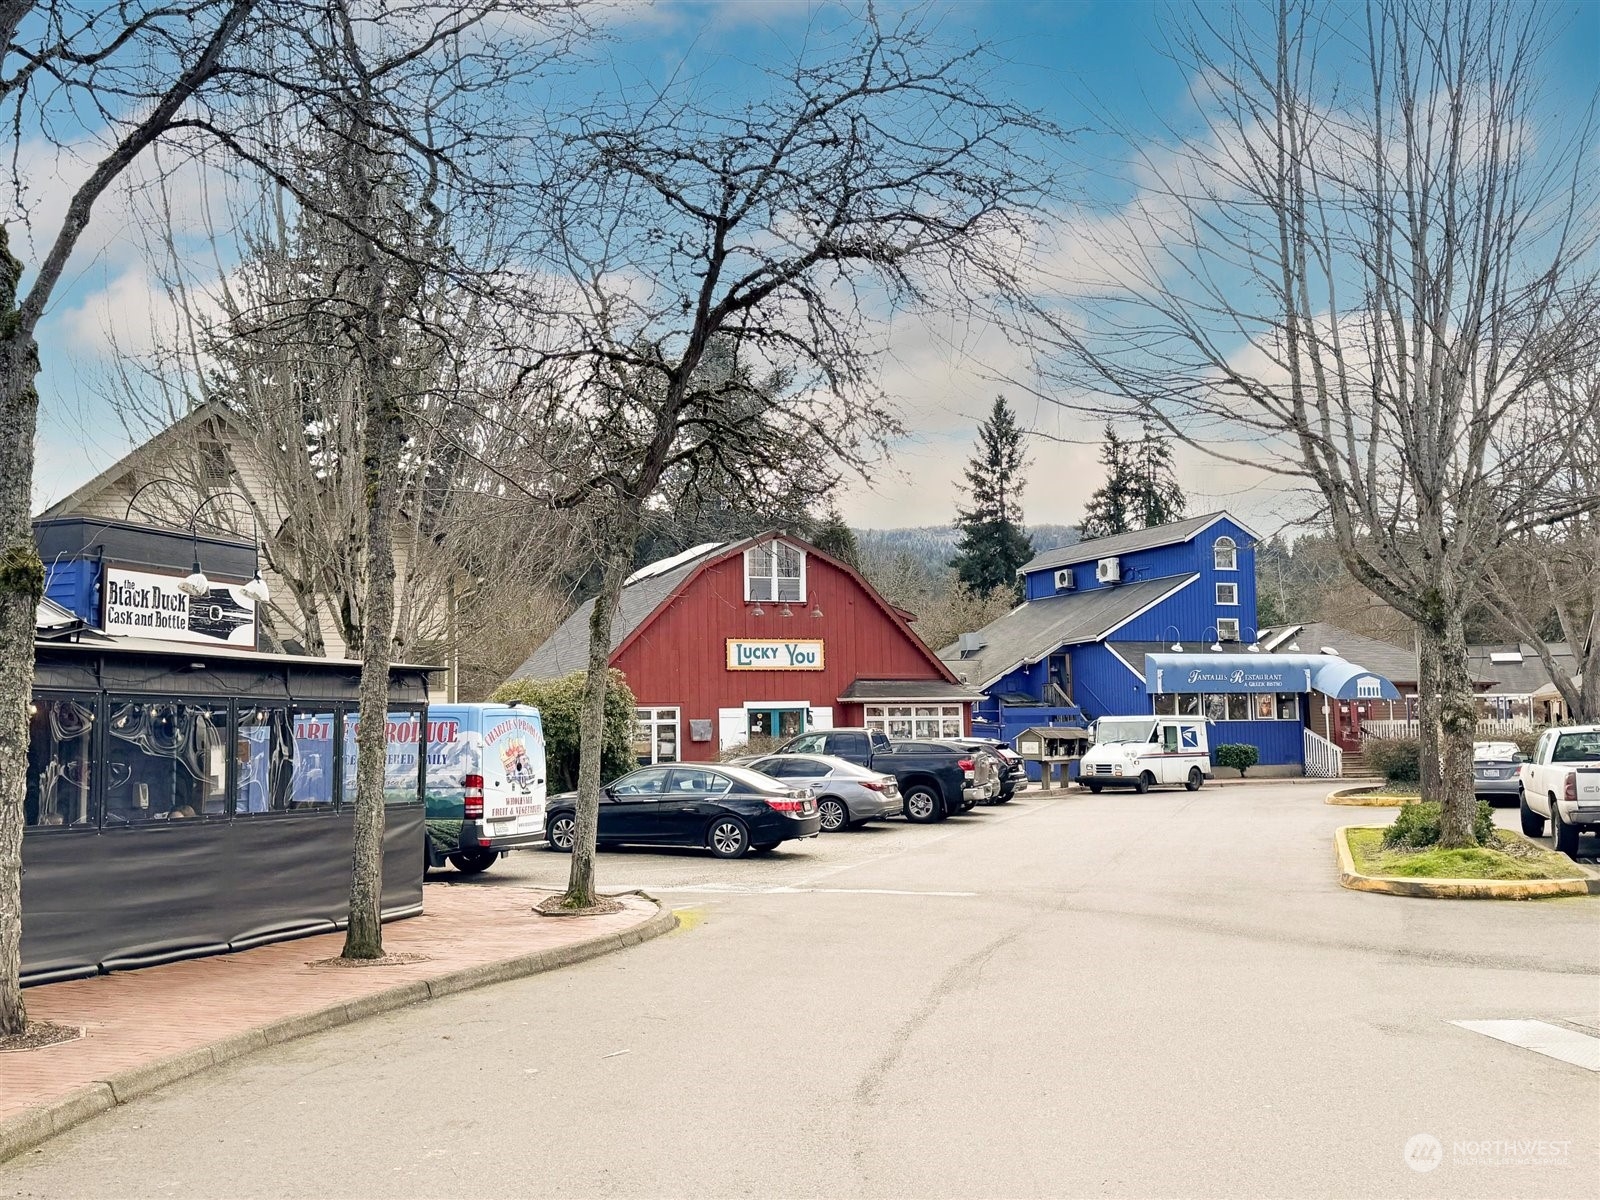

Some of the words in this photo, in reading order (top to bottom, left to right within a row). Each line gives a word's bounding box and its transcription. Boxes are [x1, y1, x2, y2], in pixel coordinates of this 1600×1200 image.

[124, 579, 136, 590] the
[108, 606, 133, 624] Cask
[134, 612, 154, 627] and
[154, 610, 186, 630] Bottle
[386, 722, 458, 744] RODUCE
[428, 754, 448, 764] AILY
